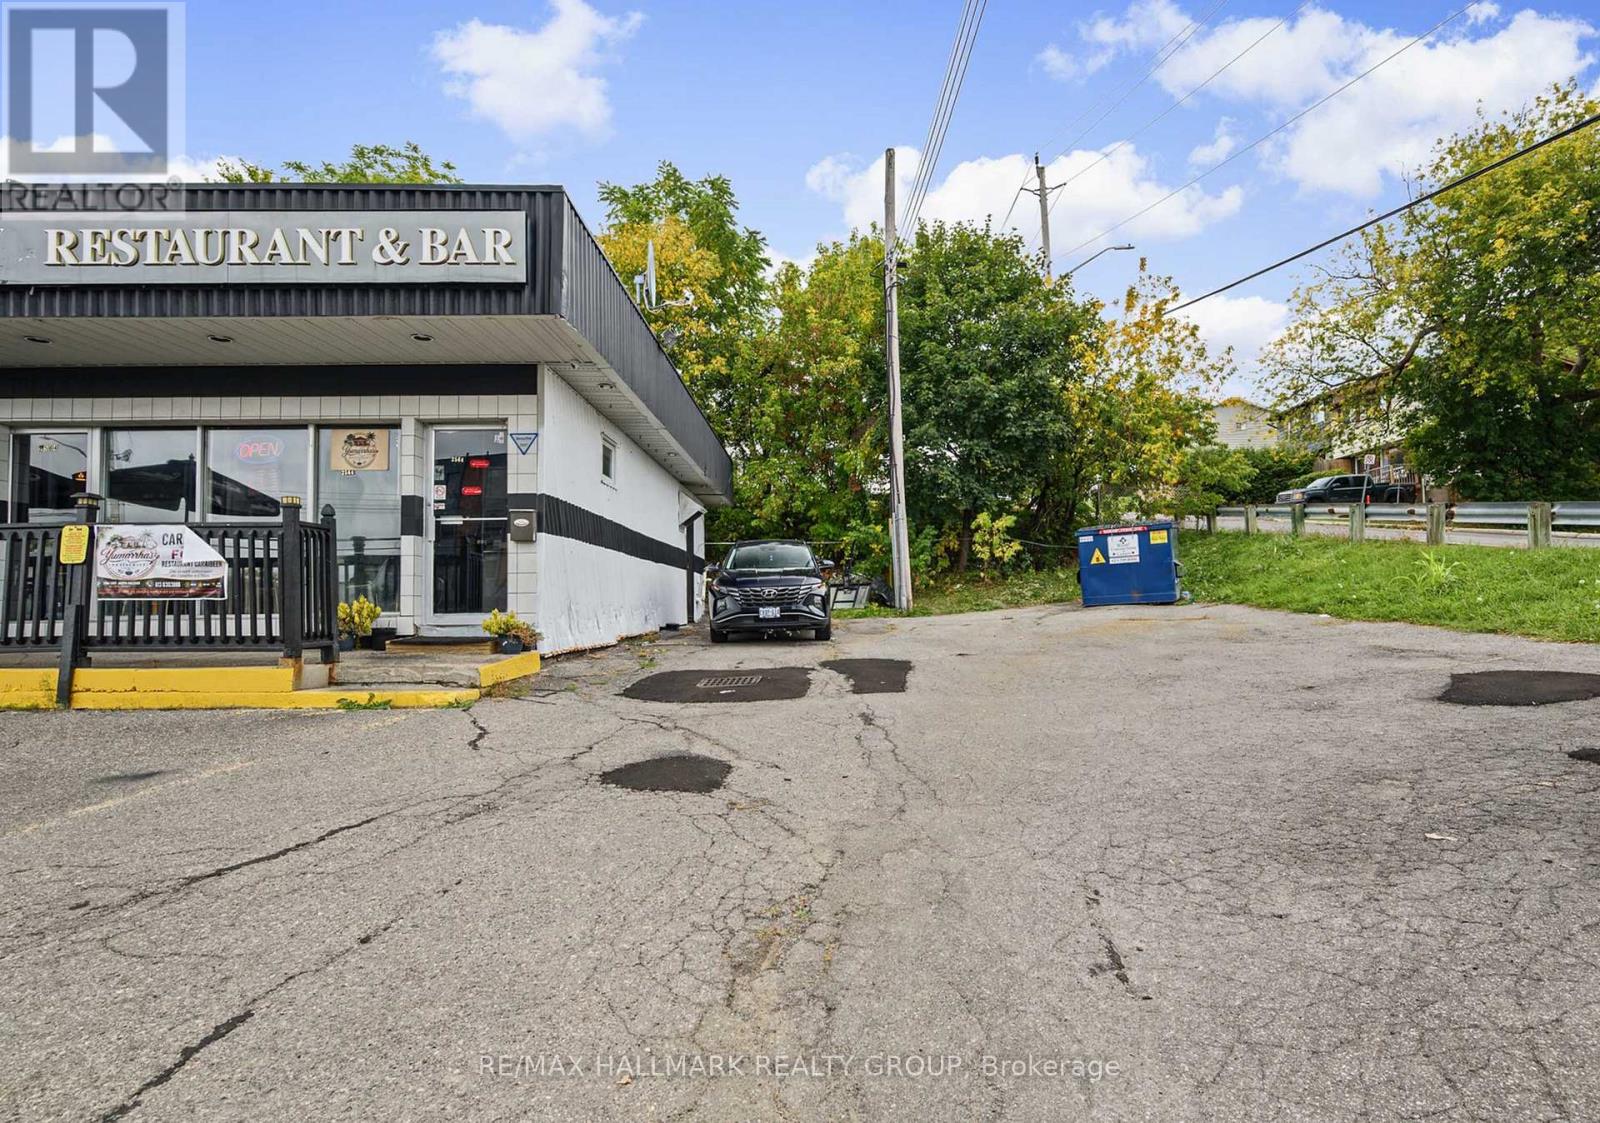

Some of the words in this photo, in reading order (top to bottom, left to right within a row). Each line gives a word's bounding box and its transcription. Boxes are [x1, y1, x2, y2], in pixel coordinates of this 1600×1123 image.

[43, 227, 364, 267] RESTAURANT
[371, 227, 409, 265] &
[418, 227, 516, 265] BAR
[239, 441, 280, 459] OPEN
